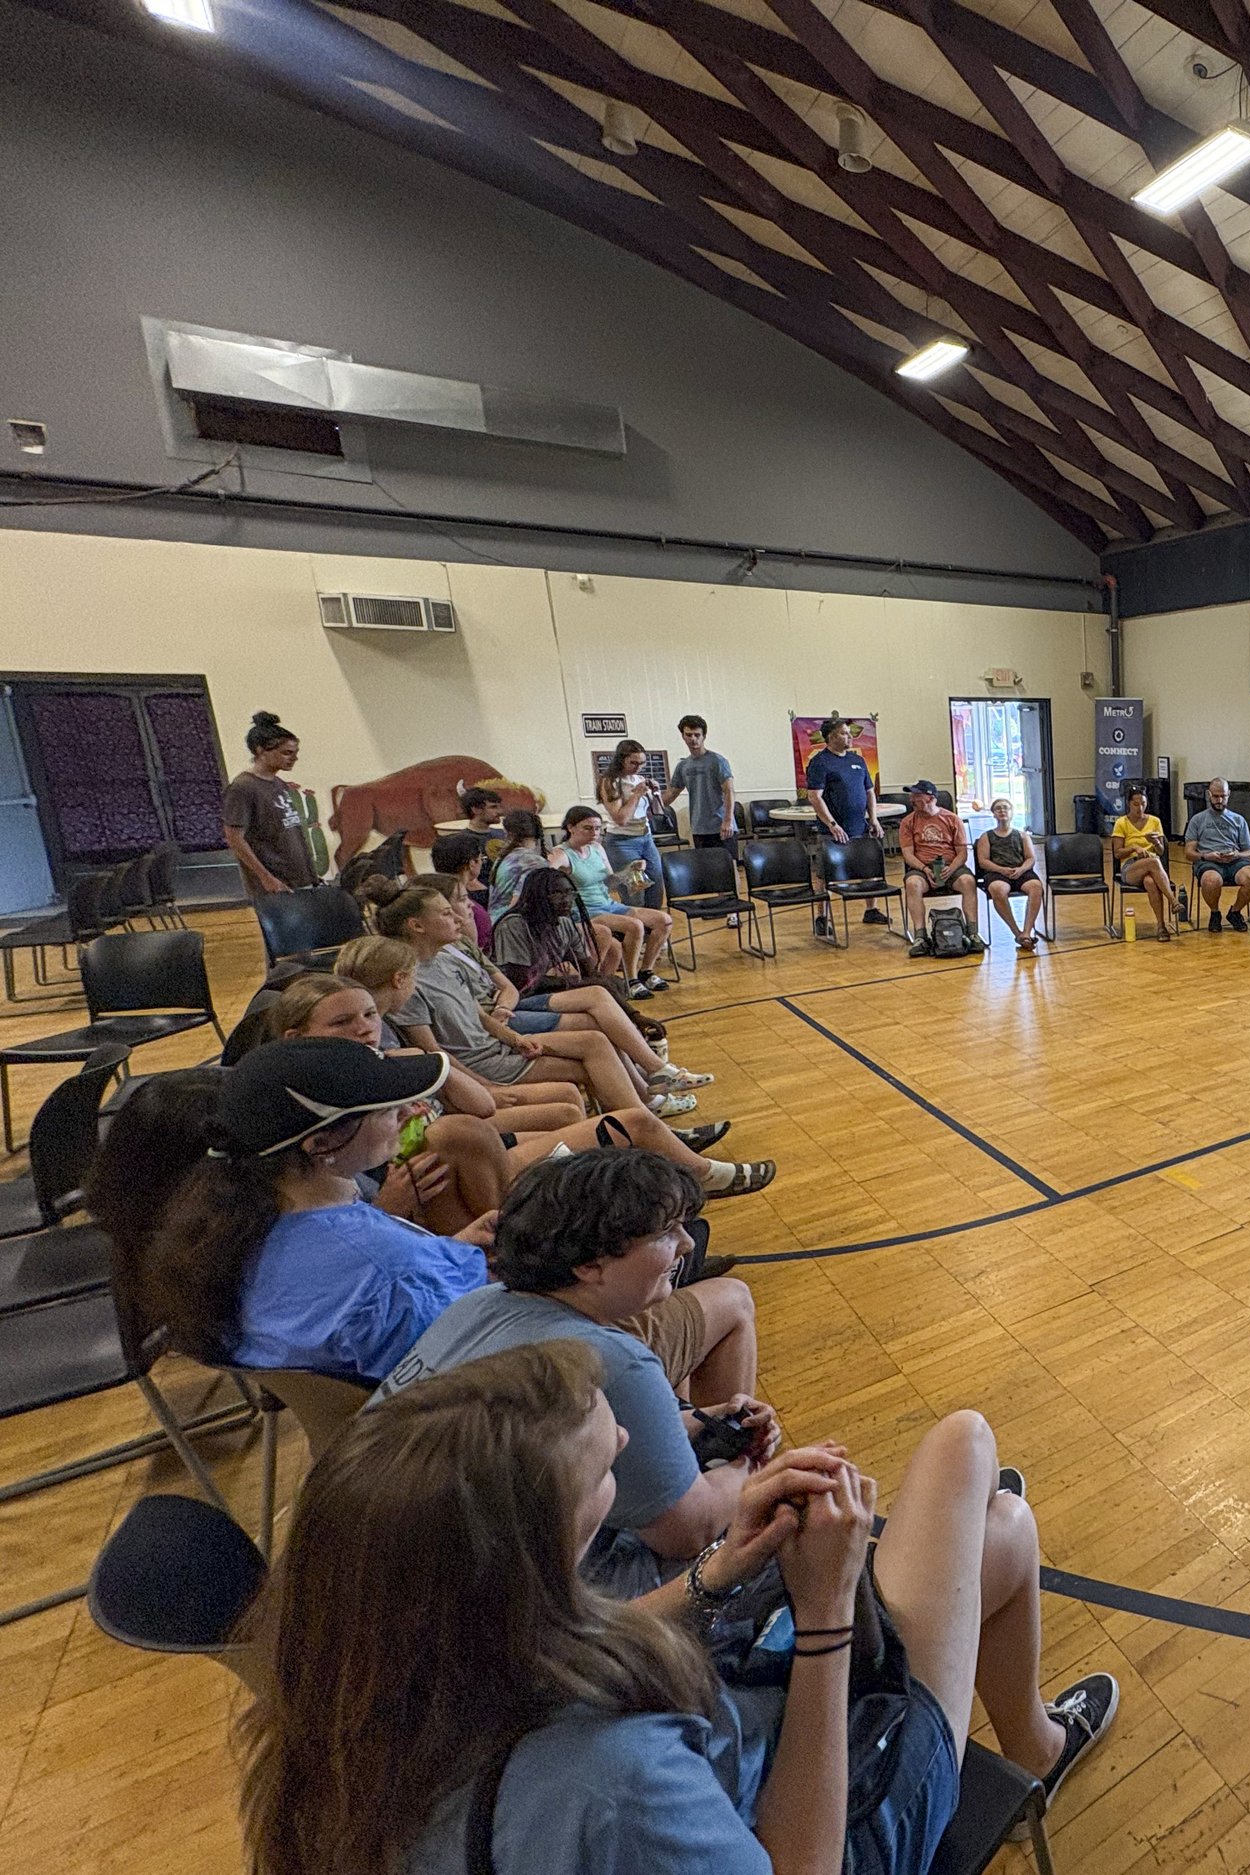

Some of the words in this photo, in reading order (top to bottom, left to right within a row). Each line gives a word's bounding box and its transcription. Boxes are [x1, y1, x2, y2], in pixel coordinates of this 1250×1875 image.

[585, 719, 602, 731] TRAIN
[602, 719, 625, 731] STATION
[1098, 746, 1138, 756] CONNECT
